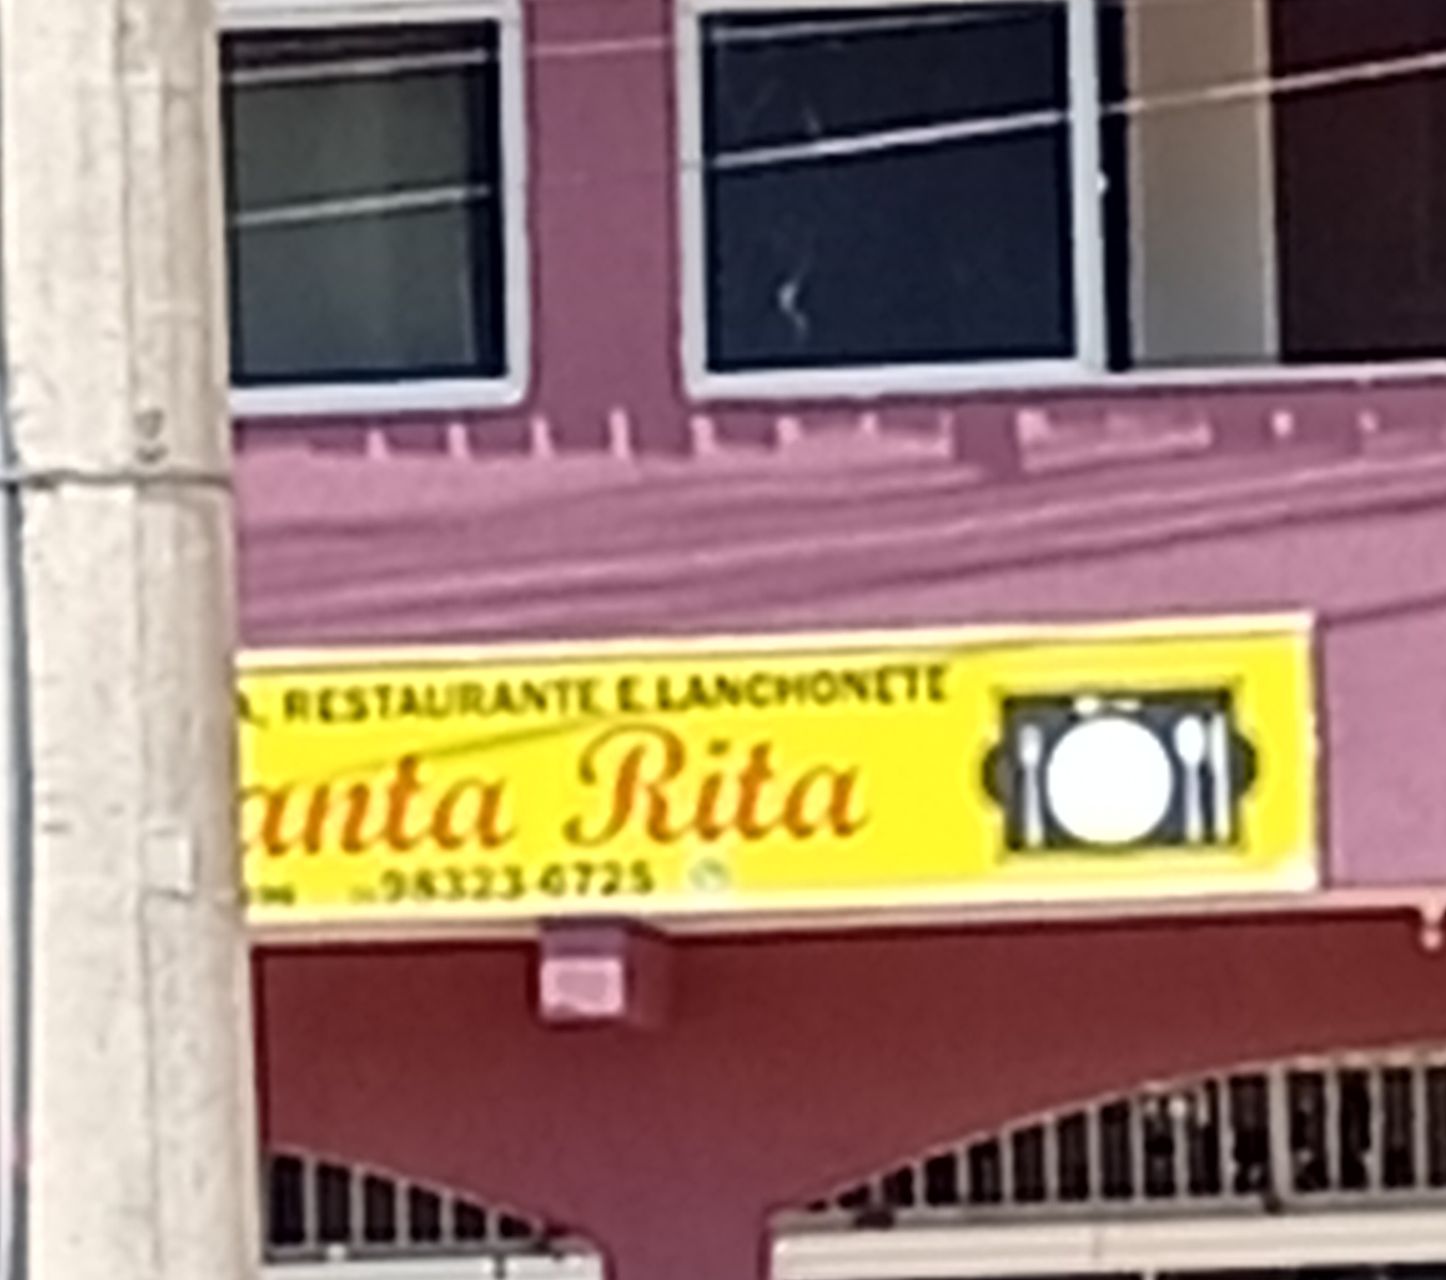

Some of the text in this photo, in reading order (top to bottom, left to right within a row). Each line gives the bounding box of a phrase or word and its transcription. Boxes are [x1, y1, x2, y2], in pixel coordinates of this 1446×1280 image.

[283, 677, 604, 723] RESTAURANTE
[616, 673, 642, 714] E
[655, 663, 948, 712] LANCHONETE
[561, 723, 869, 848] Rita
